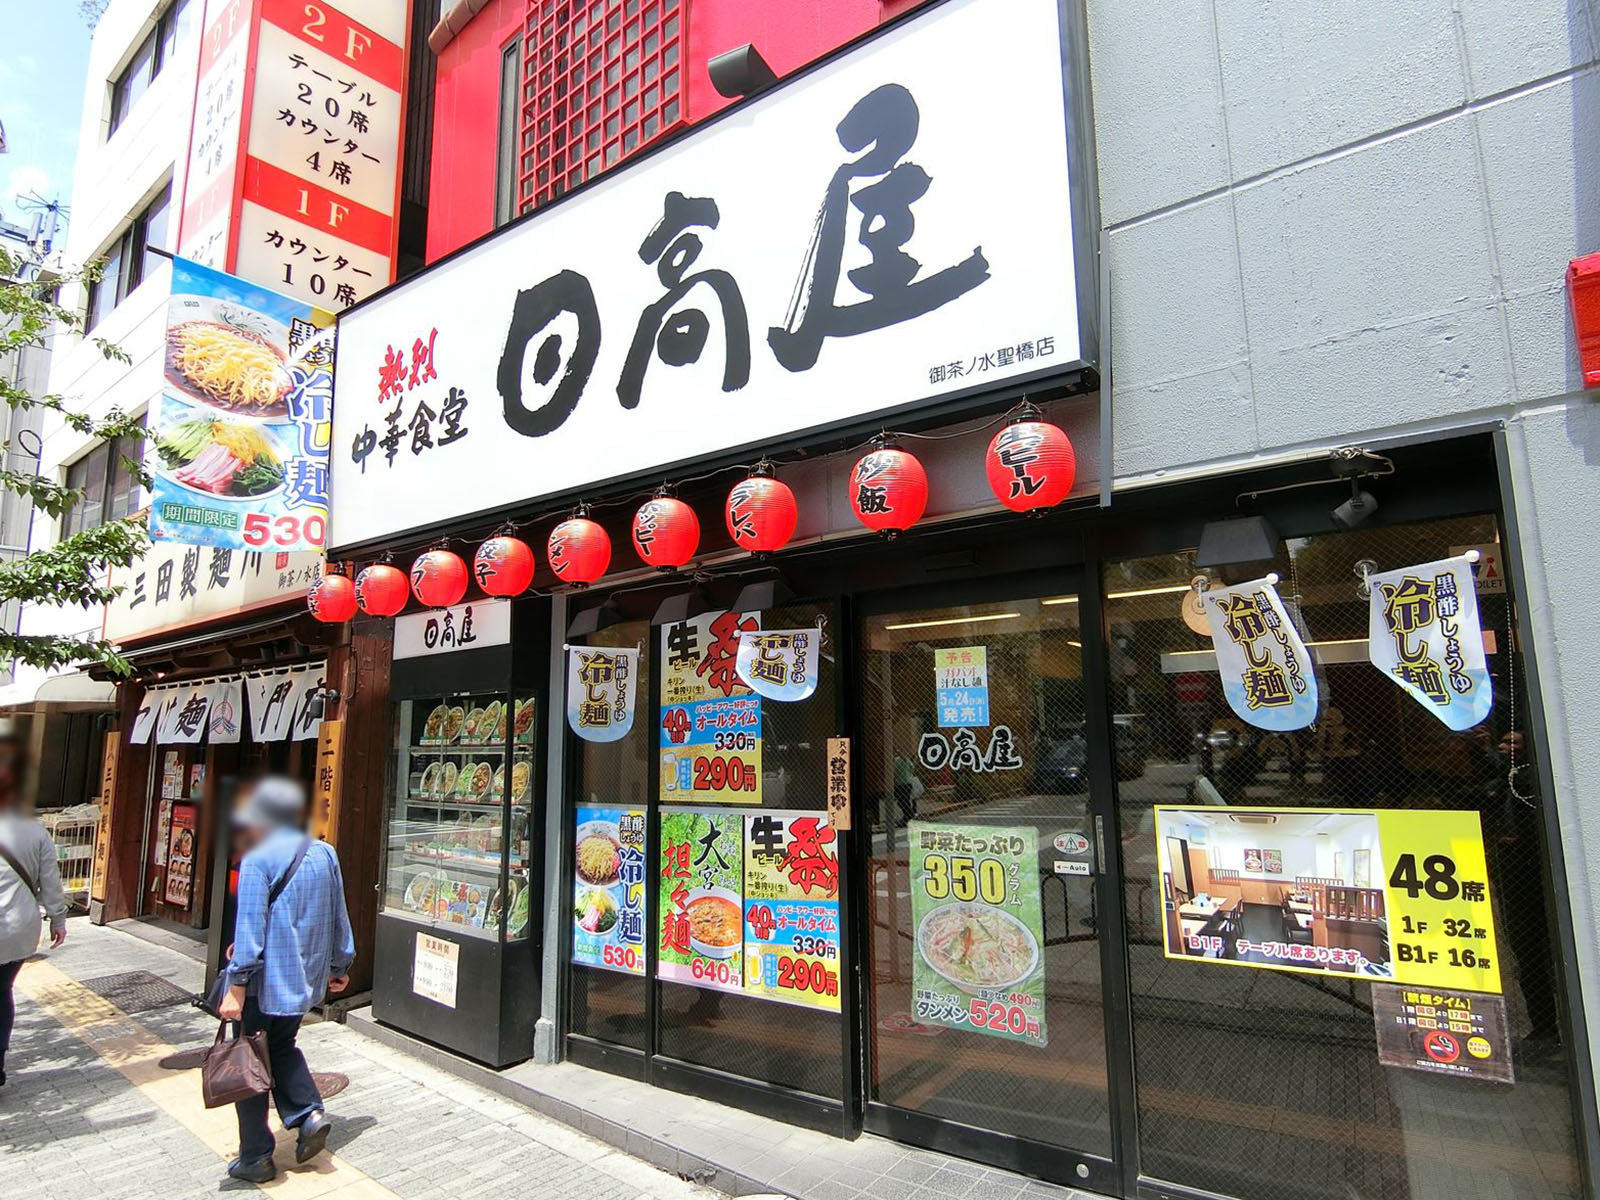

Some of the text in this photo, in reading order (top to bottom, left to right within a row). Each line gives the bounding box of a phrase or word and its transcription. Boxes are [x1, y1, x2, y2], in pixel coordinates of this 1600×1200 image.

[302, 4, 372, 61] 2F
[288, 54, 377, 107] テーブル
[297, 83, 370, 134] 20席
[276, 108, 381, 164] カウンター
[306, 152, 352, 186] 4席
[297, 190, 350, 228] 1F
[264, 230, 372, 277] カウンター
[496, 83, 991, 437] 日高屋
[282, 263, 356, 307] 10席
[378, 327, 438, 404] 熱烈
[929, 336, 1054, 384] 御茶ノ水聖橋店
[352, 385, 468, 474] 中華食堂
[853, 451, 893, 514] 炒飯
[164, 504, 238, 529] 期間限定
[1475, 578, 1503, 589] OILET
[424, 605, 477, 649] 日高屋
[1253, 591, 1307, 694] 黒酢しょうゆ
[1434, 572, 1473, 694] 黒酢しょうゆ
[668, 610, 760, 697] 生 祭
[673, 657, 697, 673] ビール
[1216, 593, 1293, 711] 冷し麺
[578, 651, 616, 728] 冷し麺
[696, 710, 758, 730] オールタイム
[918, 725, 1023, 773] 日高屋
[693, 756, 757, 792] 290円
[619, 814, 645, 832] 黒酢
[751, 816, 786, 859] 生
[920, 831, 1025, 856] 野菜たっぷり
[693, 819, 731, 891] 大宮
[757, 853, 784, 867] ビール
[1389, 853, 1486, 903] 48席
[618, 846, 646, 945] 冷し麺
[661, 836, 692, 956] 担々麺
[923, 853, 1007, 906] 350
[777, 915, 837, 932] オールタイム
[1401, 915, 1487, 940] 1F 32席
[1189, 936, 1368, 967] B1F テーブル席あります。
[1396, 942, 1491, 970] B1F 16席
[917, 1001, 968, 1024] タンメン
